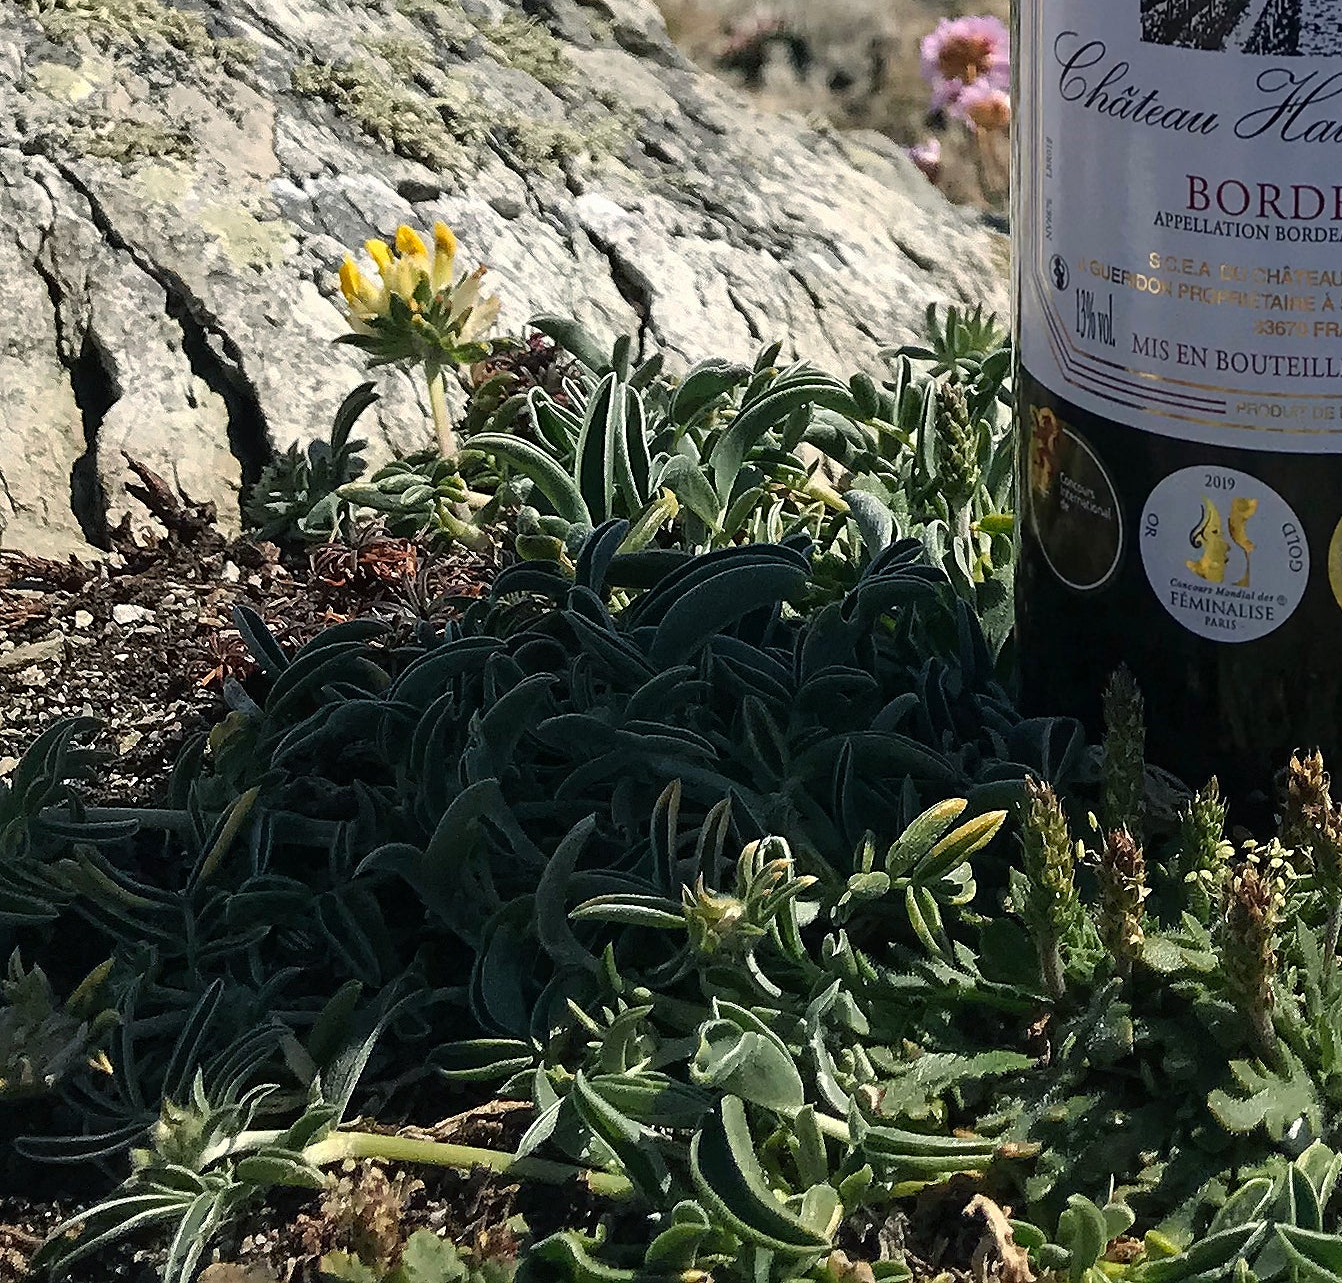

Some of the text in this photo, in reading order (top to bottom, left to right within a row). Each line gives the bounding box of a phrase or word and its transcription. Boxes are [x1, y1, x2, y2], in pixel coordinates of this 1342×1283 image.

[1054, 31, 1220, 135] Château
[1153, 211, 1270, 241] APPELLATION
[1220, 262, 1247, 281] DU
[1075, 288, 1116, 347] 13% vol.
[1131, 333, 1169, 361] MIS
[1176, 343, 1208, 368] EN
[1235, 401, 1308, 419] PRODUIT
[1313, 406, 1335, 420] DE
[1204, 474, 1237, 492] 2019
[1145, 513, 1159, 538] OR
[1281, 522, 1303, 572] GOLD
[1169, 578, 1274, 602] Concours Mondial des
[1170, 591, 1275, 621] FÉMINALISE
[1205, 616, 1237, 630] PARIS
